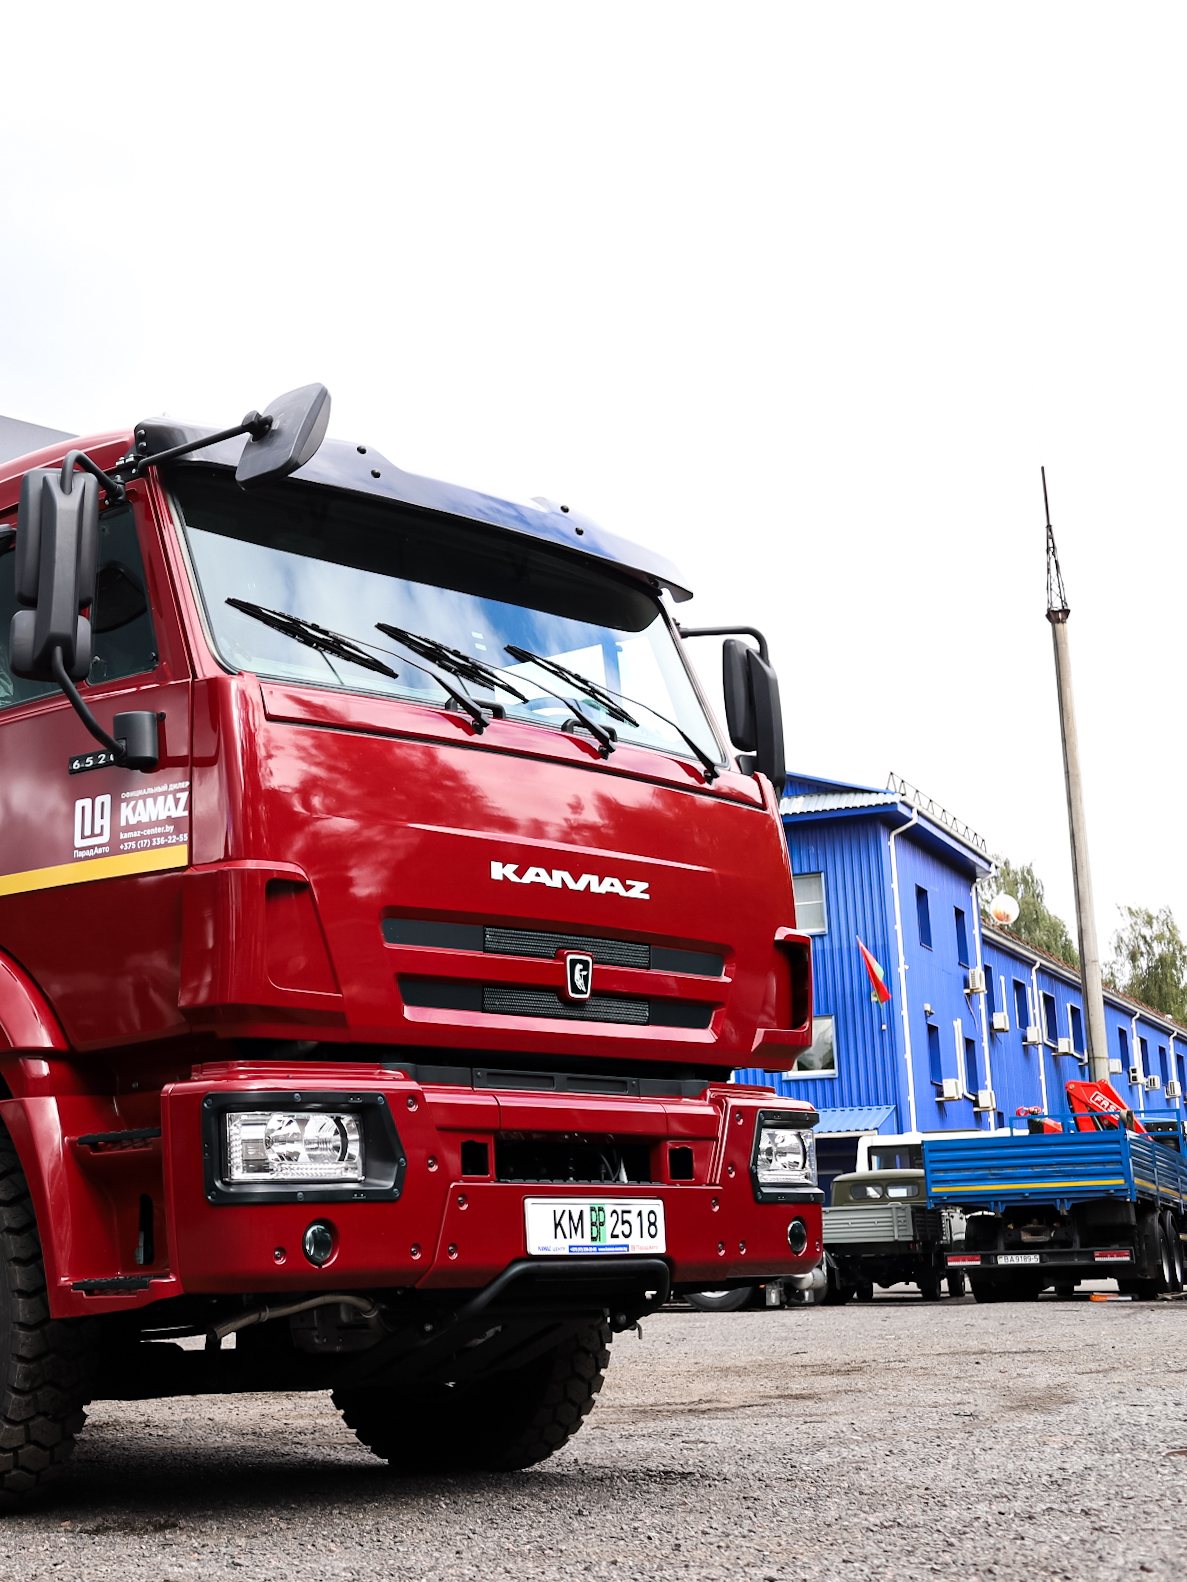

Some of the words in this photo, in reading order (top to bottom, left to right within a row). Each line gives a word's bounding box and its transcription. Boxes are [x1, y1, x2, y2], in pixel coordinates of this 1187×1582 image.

[120, 791, 189, 827] KAMAZ
[120, 825, 175, 840] kamaz-center.by
[120, 841, 136, 850] +375
[137, 839, 151, 849] (17)
[152, 833, 189, 846] 336-22-55
[74, 846, 110, 858] ПарадАвто
[490, 860, 651, 900] KAMAZ
[553, 1209, 585, 1240] KM
[610, 1209, 658, 1240] 2518
